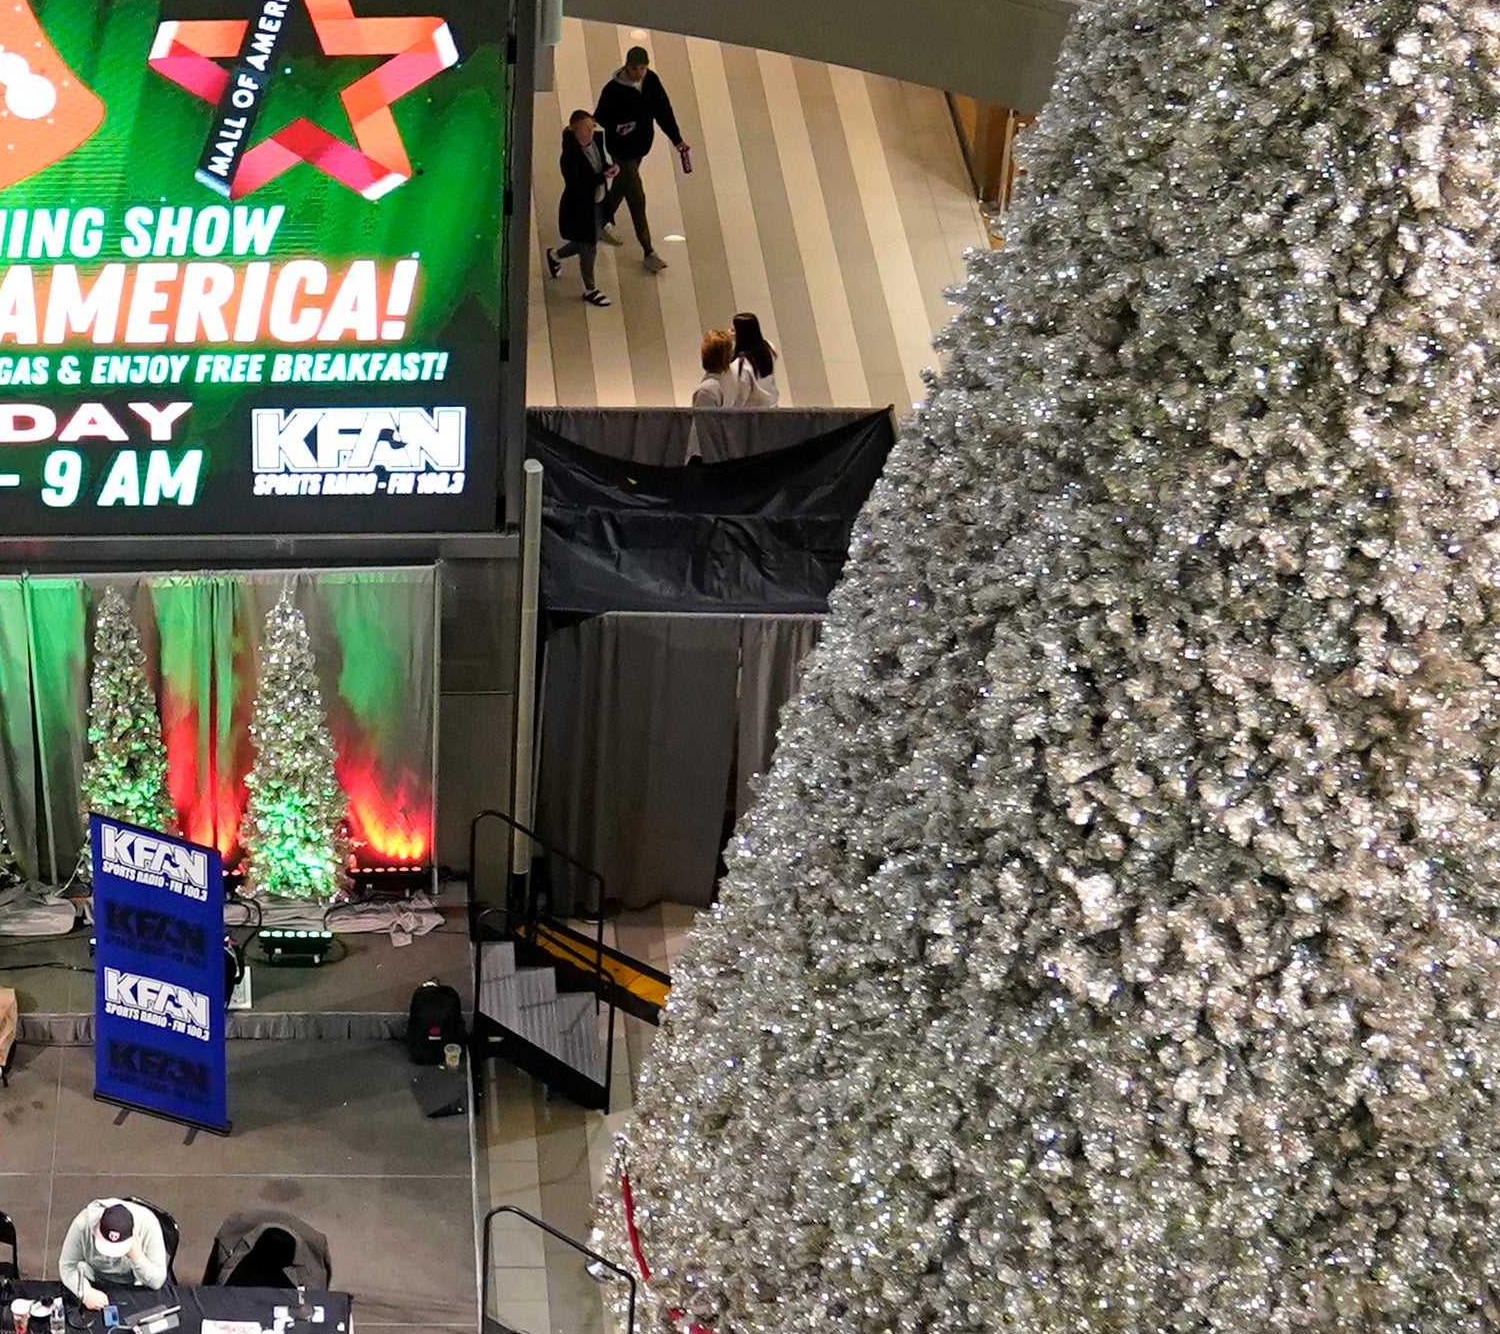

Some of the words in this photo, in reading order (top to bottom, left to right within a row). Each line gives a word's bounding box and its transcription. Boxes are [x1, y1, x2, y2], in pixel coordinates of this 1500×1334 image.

[207, 116, 248, 177] MALL
[231, 73, 259, 109] OF
[121, 204, 287, 258] SHOW
[56, 355, 82, 385] &
[90, 354, 191, 385] ENJOY
[195, 353, 266, 383] FREE
[271, 351, 449, 383] BREAKFAST!
[251, 406, 467, 473] KFAN
[40, 450, 82, 509] 9
[95, 448, 204, 508] AM
[253, 473, 322, 495] SPORTS
[322, 473, 378, 495] RADIO
[387, 473, 415, 495] FM
[417, 472, 466, 495] 100.3
[101, 823, 208, 890] KFAN
[102, 860, 136, 881] SPORTS
[136, 870, 165, 888] RADIO
[169, 880, 183, 895] FM
[184, 884, 208, 902] 100.3
[104, 966, 210, 1030] KFAN
[105, 1002, 140, 1021] SPORTS
[140, 1011, 168, 1028] RADIO
[172, 1020, 186, 1034] FM
[187, 1024, 210, 1042] 100.3
